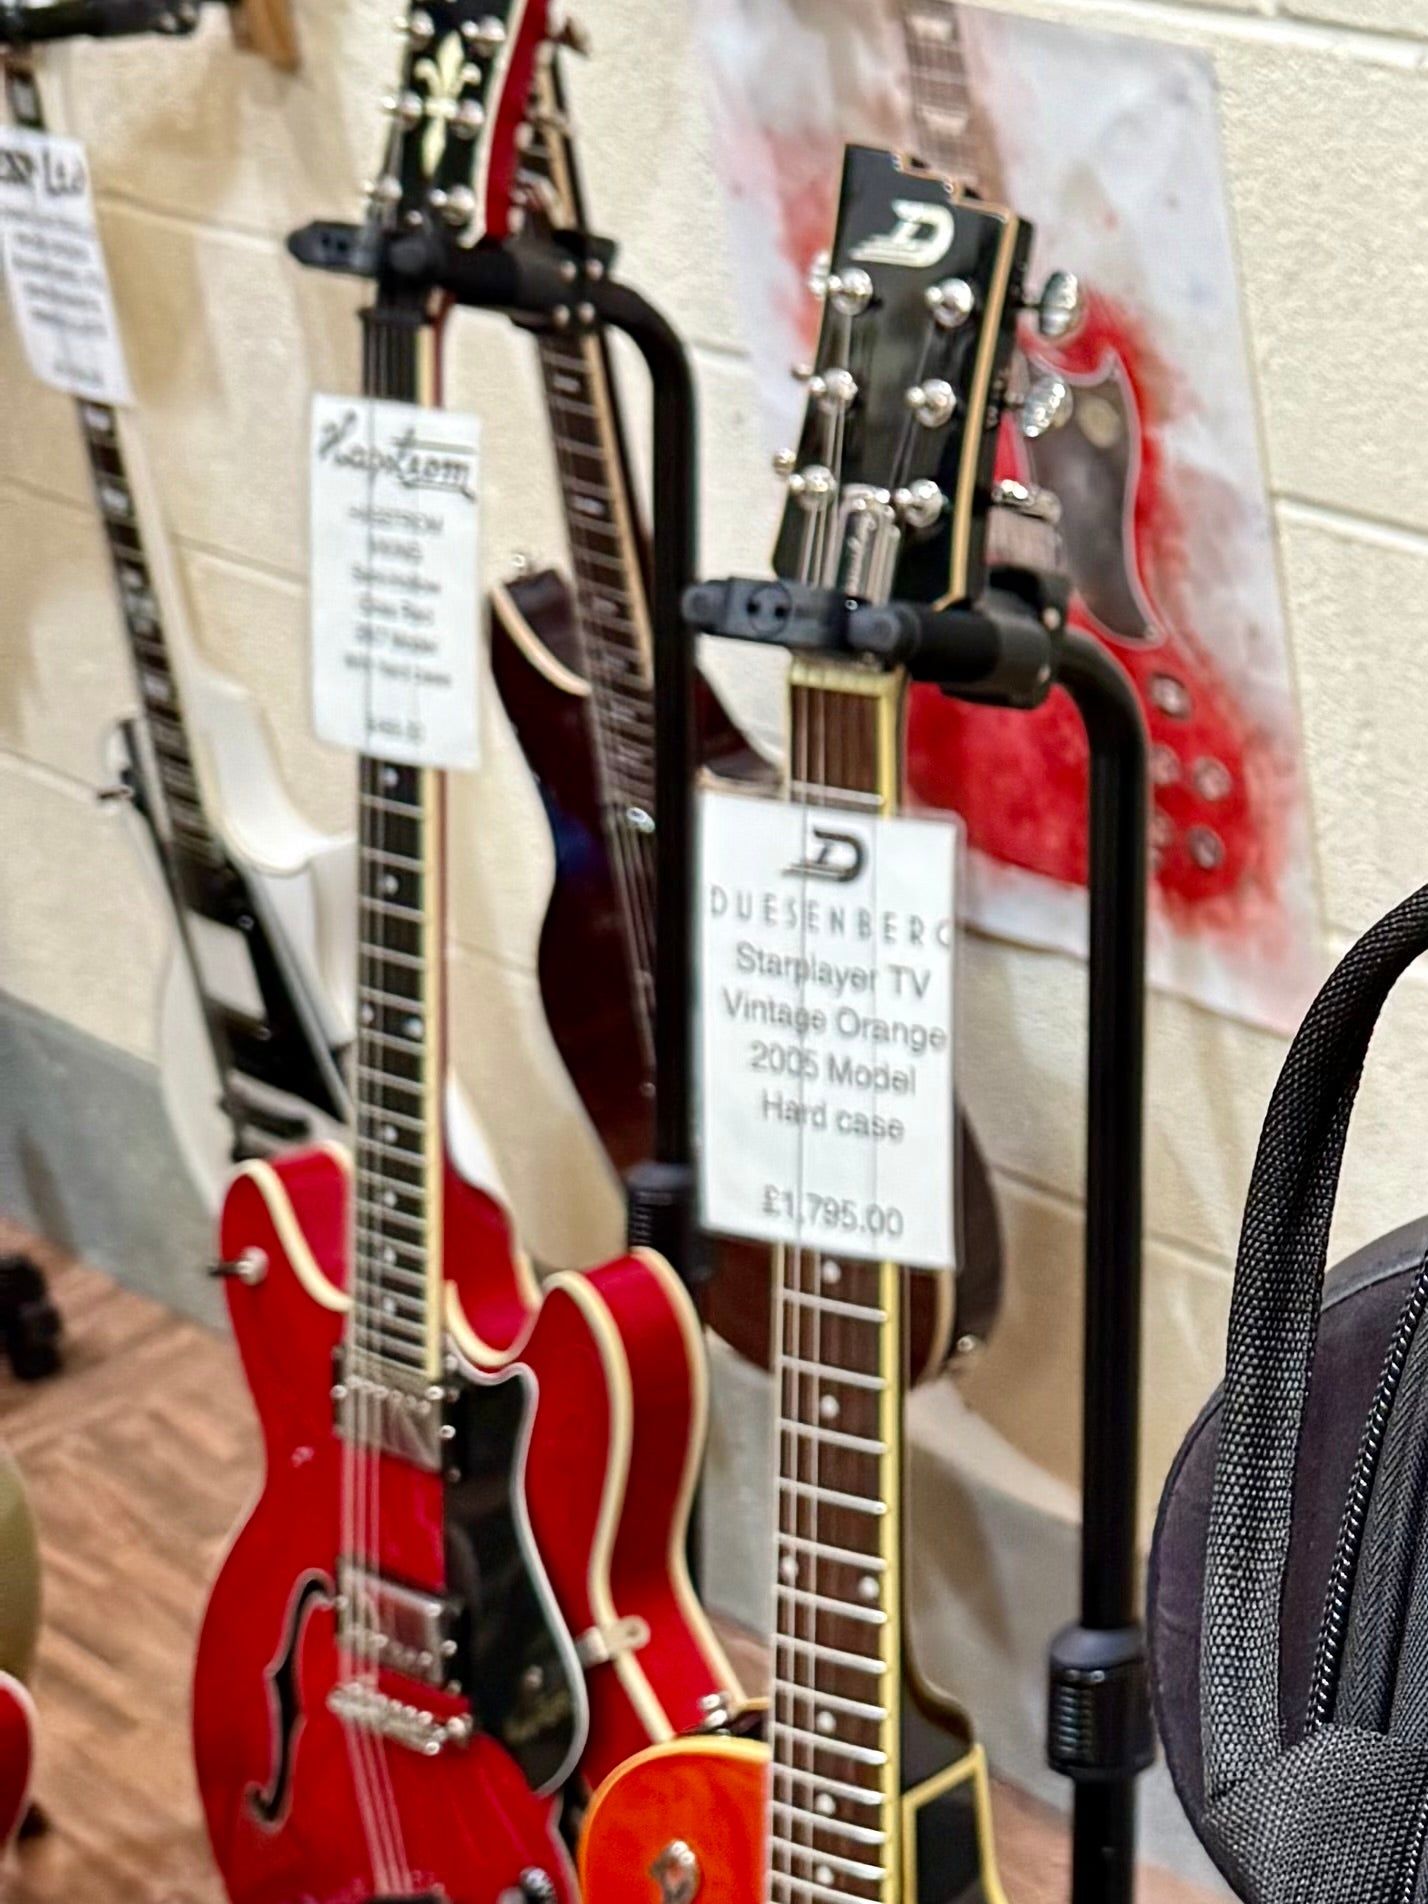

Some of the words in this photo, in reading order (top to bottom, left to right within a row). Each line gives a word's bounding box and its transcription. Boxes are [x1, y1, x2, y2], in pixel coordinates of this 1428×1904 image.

[736, 942, 878, 993] Starplayer
[888, 964, 931, 1001] TV
[723, 988, 826, 1036] Vintage
[837, 1007, 947, 1052] Orange
[751, 1041, 818, 1083] 2005
[826, 1051, 916, 1096] Model
[761, 1091, 827, 1130] Hard
[837, 1108, 905, 1143] case
[761, 1184, 904, 1237] £1,795.00
